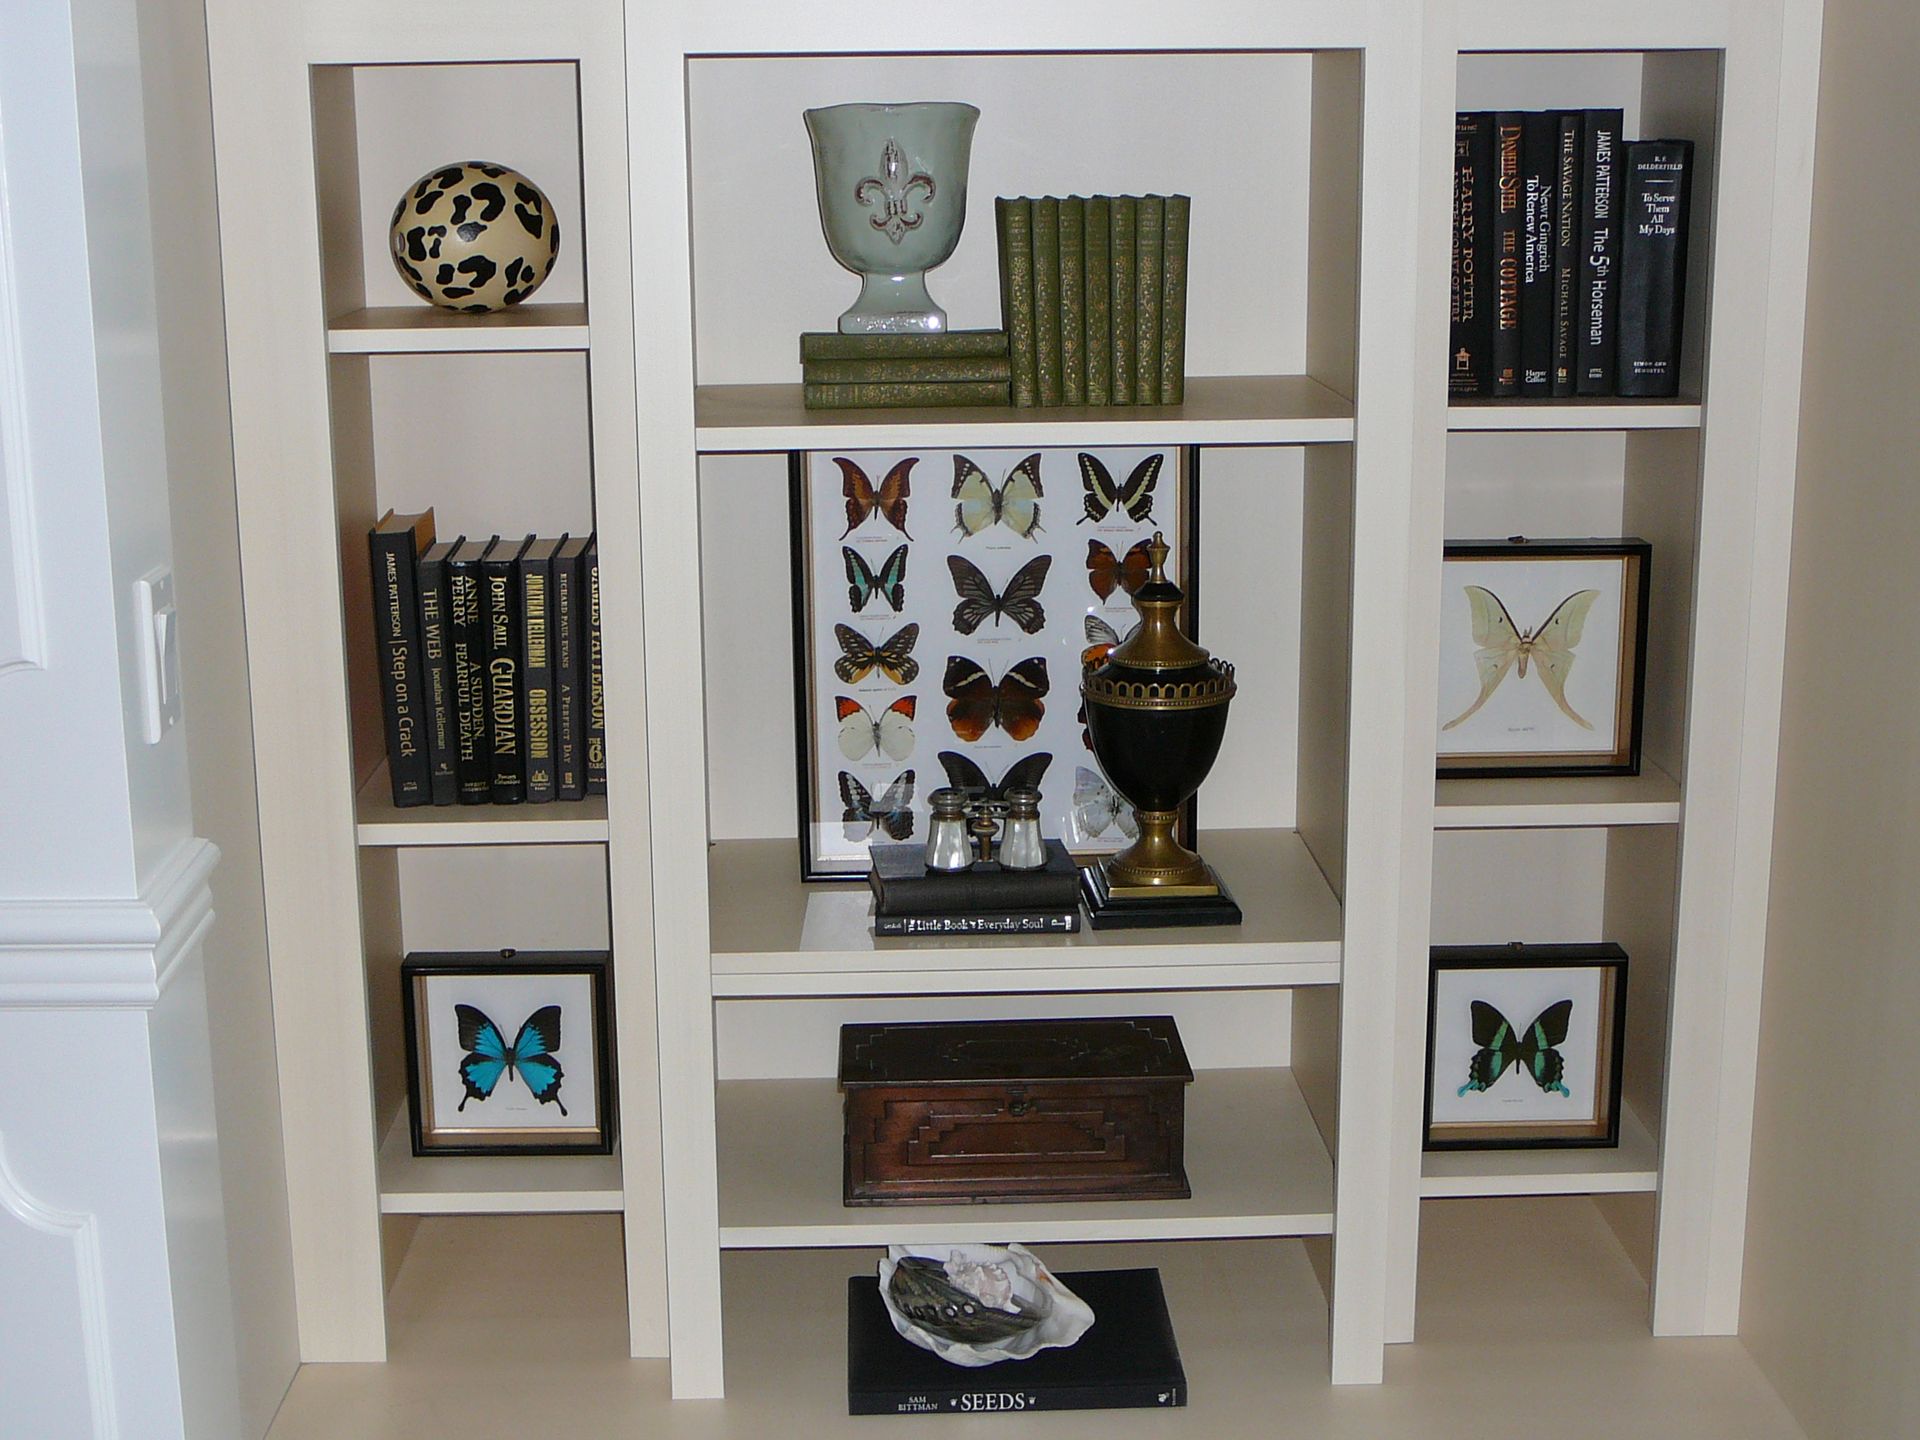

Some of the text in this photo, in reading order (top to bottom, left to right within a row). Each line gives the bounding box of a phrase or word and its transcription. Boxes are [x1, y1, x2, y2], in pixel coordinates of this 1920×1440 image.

[1499, 125, 1521, 214] DANIELLE STEEL
[1561, 130, 1575, 247] THE SAVAGE NATION
[1594, 130, 1611, 219] JAMES PATTERSON
[1642, 193, 1675, 202] To Serve
[1645, 203, 1670, 213] Them
[1461, 166, 1474, 323] HARRY POTTER
[1525, 175, 1539, 284] To Renew America
[1536, 185, 1551, 273] Newt Gingrich
[1639, 225, 1675, 236] My Days
[1651, 214, 1663, 223] All
[1499, 230, 1518, 330] THE COTTAGE
[1558, 268, 1571, 359] MICHAEL SAVAGE
[1590, 228, 1610, 346] The 5th Horseman
[1525, 369, 1547, 377] Harper
[385, 552, 401, 637] JAMES PATTERSON
[423, 588, 442, 660] THE WEB
[452, 575, 466, 628] PERRY
[465, 576, 479, 624] ANNE
[489, 576, 509, 650] JOHN SAUL
[526, 573, 547, 668] JONATHAN KELLERMAN
[560, 573, 570, 668] RICHARD PAUL EVANS
[391, 647, 417, 757] Step on a Crack
[431, 668, 447, 750] Jonathan Kellerman
[455, 642, 473, 762] FEARFUL DEATH
[470, 662, 485, 740] A SUDDEN,
[490, 657, 516, 756] GUARDIAN
[529, 688, 549, 759] OBSESSION
[562, 684, 572, 764] A PERFECT DAY
[917, 919, 942, 931] Little
[944, 918, 969, 931] Book
[977, 917, 1021, 933] Everyday
[1022, 917, 1044, 930] Soul
[898, 1403, 938, 1412] BITTMAN
[908, 1396, 927, 1404] SAM
[960, 1392, 1026, 1411] SEEDS
